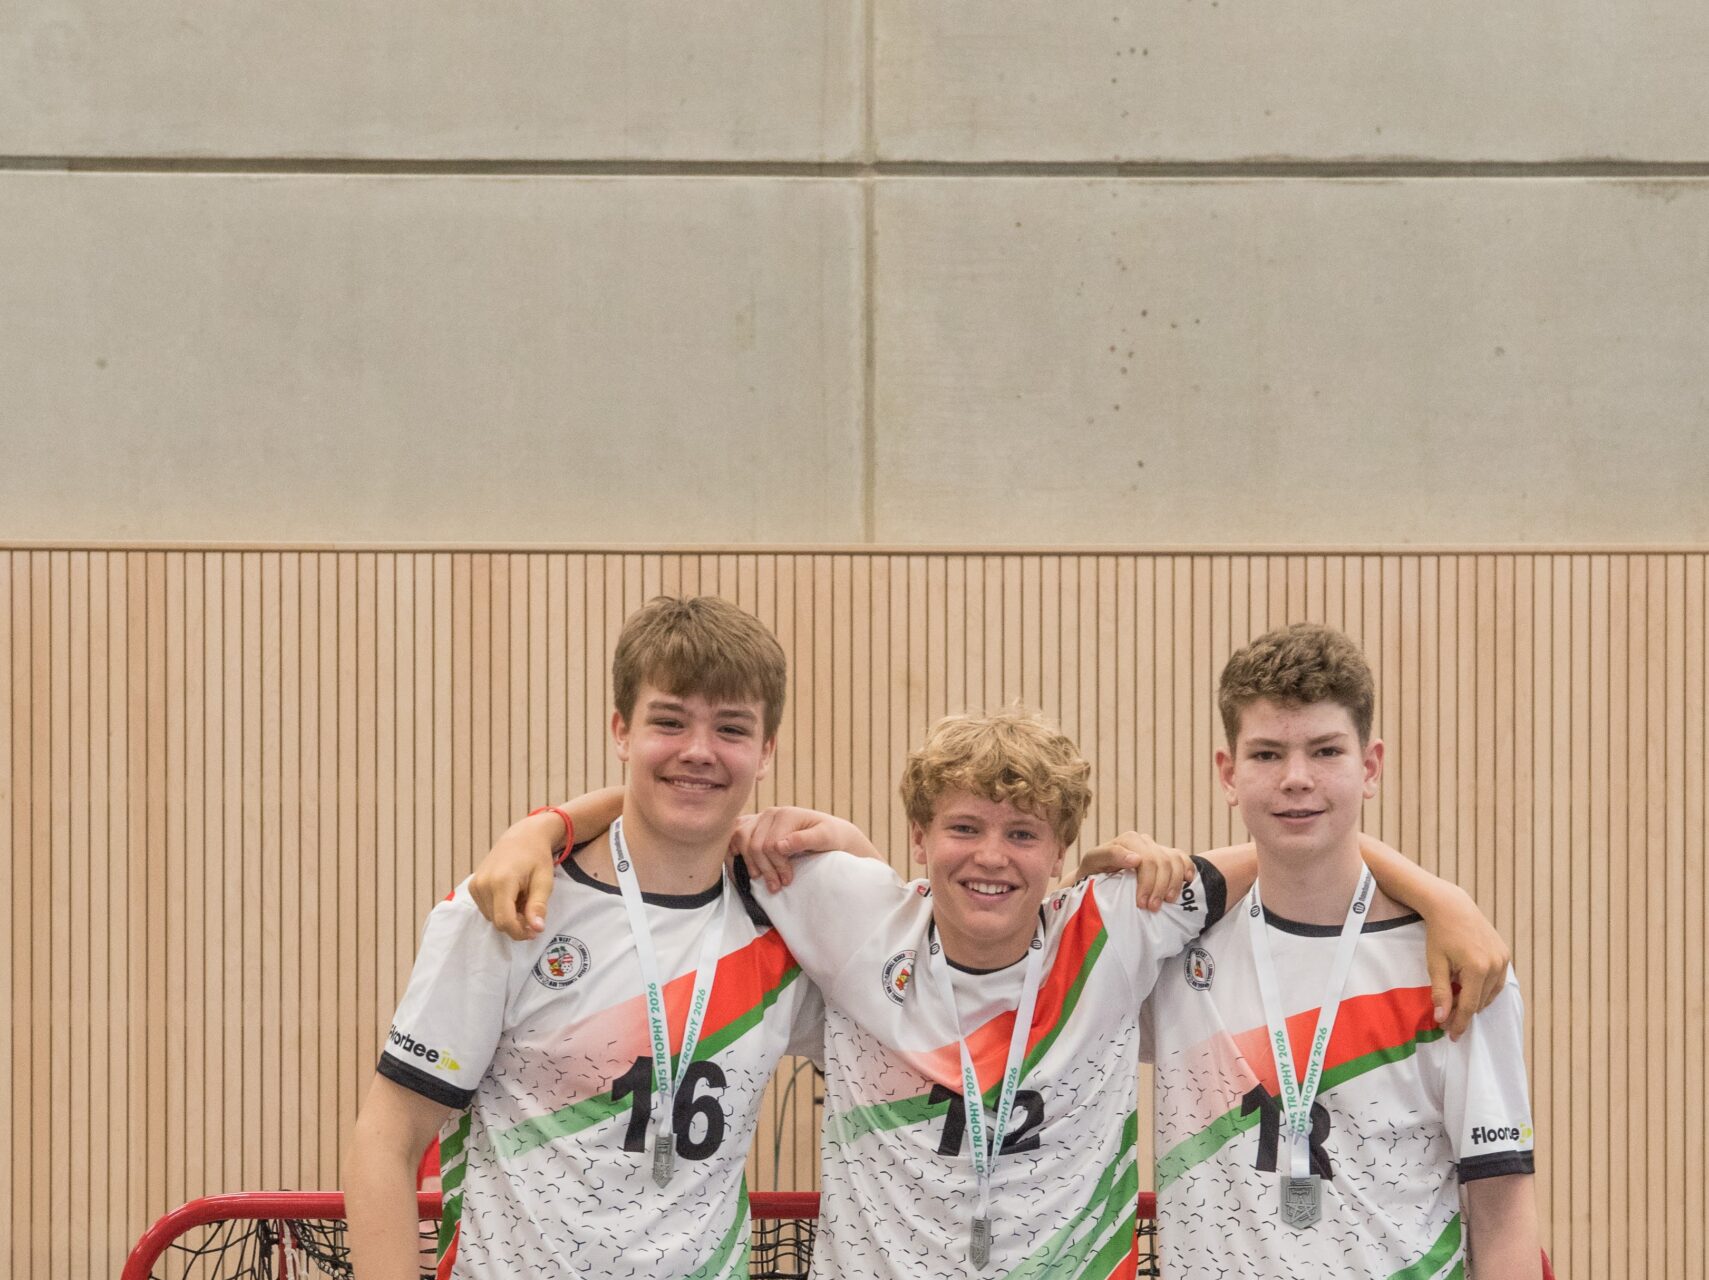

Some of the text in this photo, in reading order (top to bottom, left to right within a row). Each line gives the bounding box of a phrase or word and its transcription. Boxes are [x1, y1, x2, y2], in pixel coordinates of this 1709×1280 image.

[648, 982, 669, 1092] U15 TROPHY 2026
[682, 1018, 699, 1065] TROPHY
[694, 989, 706, 1016] 2026
[1274, 1030, 1288, 1058] 2026
[965, 1067, 976, 1097] 2026
[1280, 1062, 1298, 1109] TROPHY
[1302, 1060, 1320, 1107] TROPHY
[1313, 1027, 1328, 1057] 2026
[611, 1055, 727, 1161] 16
[969, 1101, 982, 1148] TROPHY
[995, 1099, 1010, 1146] TROPHY
[1006, 1067, 1018, 1096] 2026
